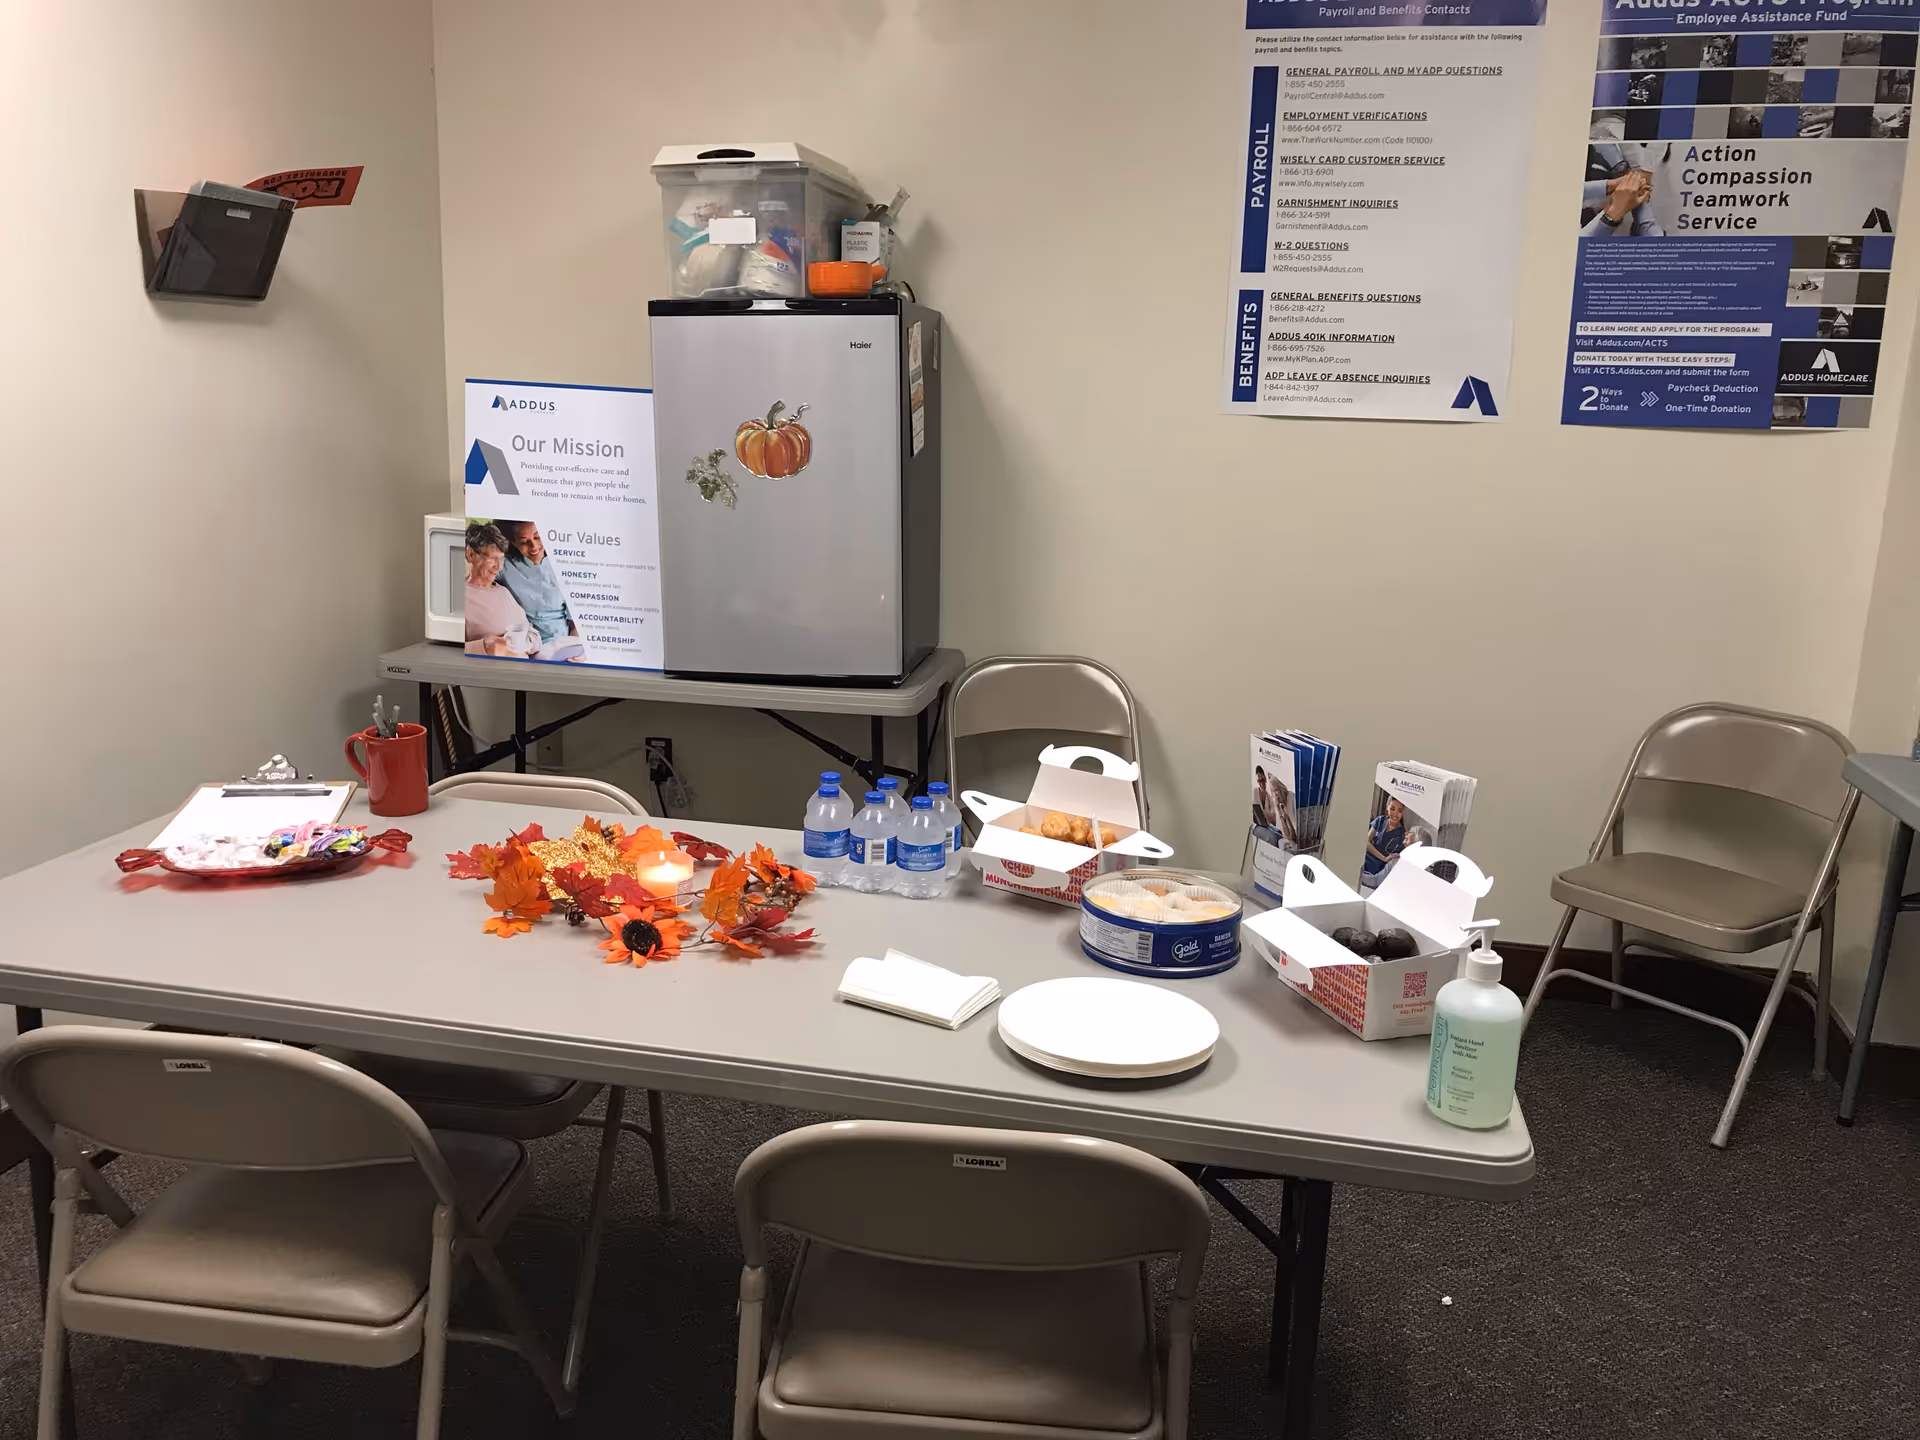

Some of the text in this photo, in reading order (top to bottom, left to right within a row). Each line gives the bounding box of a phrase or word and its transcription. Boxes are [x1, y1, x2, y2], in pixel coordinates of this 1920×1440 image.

[1319, 4, 1471, 18] Payroll and Benefits Contacts
[1676, 10, 1848, 26] Employee Assistance Fund
[1491, 33, 1523, 41] following
[1255, 46, 1279, 54] payroll
[1286, 66, 1503, 76] GENERAL PAYROLL AND MYADP QUESTIONS
[1285, 80, 1345, 88] 1-855-450-2555
[1284, 92, 1385, 100] PayrollCentral@Addus.com
[1283, 111, 1427, 121] EMPLOYMENT VERIFICATIONS
[1282, 124, 1342, 132] 1-866-604-6572
[1281, 136, 1380, 144] www.TheWorkNumber.com
[1382, 136, 1404, 145] (Code
[1684, 145, 1756, 163] Action
[1250, 123, 1270, 208] PAYROLL
[1280, 156, 1445, 166] WISELY CARD CUSTOMER SERVICE
[1279, 168, 1334, 176] 1-866-313-6901
[1682, 167, 1812, 188] Compassion
[1279, 180, 1365, 189] www.info.mywisely.com
[1277, 199, 1399, 209] GARNISHMENT INQUIRIES
[1680, 191, 1790, 208] Teamwork
[1276, 211, 1330, 219] 1-866-324-5191
[1677, 213, 1757, 230] Service
[1275, 223, 1368, 231] Garnishment@Addus.com
[1274, 241, 1349, 251] W-2 QUESTIONS
[1272, 265, 1364, 273] W2Requests@Addus.com
[1270, 292, 1421, 303] GENERAL BENEFITS QUESTIONS
[1269, 304, 1325, 312] 1-866-218-4272
[1269, 315, 1344, 324] Benefits@Addus.com
[1268, 332, 1395, 343] ADDUS 401K INFORMATION
[850, 341, 872, 349] Haier
[1239, 302, 1257, 387] BENEFITS
[1267, 344, 1325, 352] 1-866-695-7526
[1575, 338, 1668, 348] Visit Addus.com/ACTS
[1266, 355, 1351, 364] www.MyKPlan.ADP.com
[1573, 366, 1750, 377] Visit ACTS.Addus.com and submit the form
[1265, 372, 1431, 384] ADP LEAVE OF ABSENCE INQUIRIES
[1780, 373, 1869, 382] ADDUS HOMECARE
[1264, 384, 1319, 392] 1-844-842-1397
[1600, 387, 1623, 398] Ways
[1667, 383, 1759, 394] Paycheck Deduction
[1263, 394, 1353, 404] LeaveAdmin@Addus.com
[1579, 386, 1599, 411] 2
[1600, 395, 1609, 403] to
[1703, 394, 1716, 403] OR
[509, 399, 556, 411] ADDUS
[1599, 403, 1629, 412] Donate
[1665, 403, 1752, 413] One-Time Donation
[511, 434, 625, 458] Our Mission
[520, 461, 553, 472] Providing
[555, 464, 599, 475] cost-effective
[616, 467, 630, 476] and
[526, 476, 630, 490] assistance that gives people the
[531, 489, 648, 504] freedom to remain in their homes.
[547, 529, 621, 546] Our Values
[553, 549, 586, 557] SERVICE
[561, 570, 598, 579] HONESTY
[570, 592, 620, 601] COMPASSION
[578, 614, 644, 624] ACCOUNTABILITY
[586, 635, 636, 644] LEADERSHIP
[1400, 780, 1425, 791] ARCADIA
[1174, 939, 1200, 959] Gold
[1335, 974, 1367, 1000] MUNCH
[1334, 984, 1366, 1011] MUNCH
[1333, 995, 1365, 1022] MUNCH
[1332, 1005, 1364, 1034] MUNCH
[1454, 1042, 1478, 1053] Sanitizer
[1468, 1039, 1485, 1047] Hand
